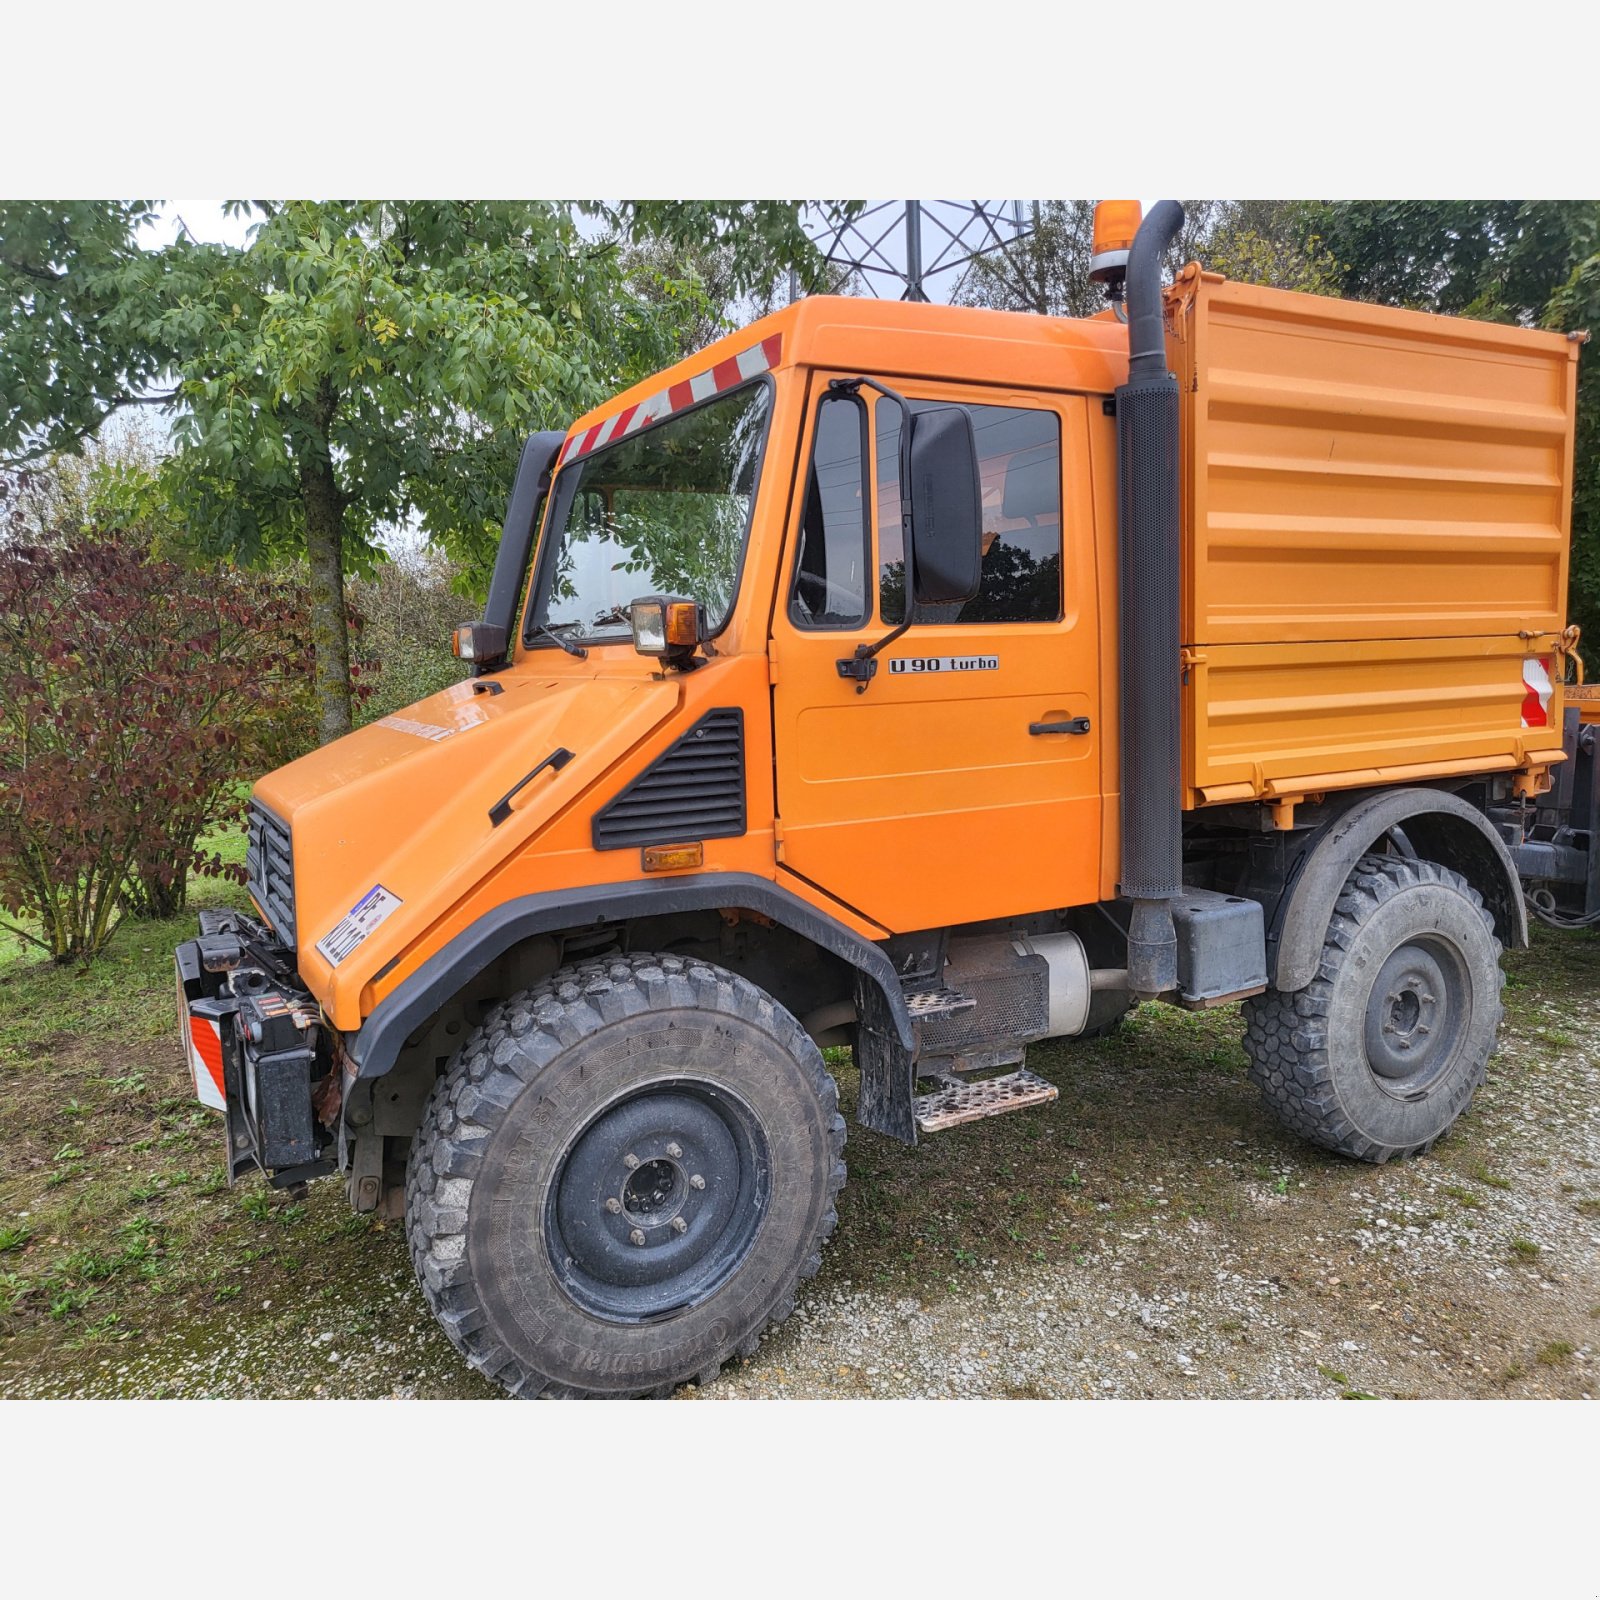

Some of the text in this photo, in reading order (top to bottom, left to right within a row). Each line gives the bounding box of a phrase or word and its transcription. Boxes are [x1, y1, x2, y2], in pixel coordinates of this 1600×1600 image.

[891, 657, 997, 672] U 90 turbo
